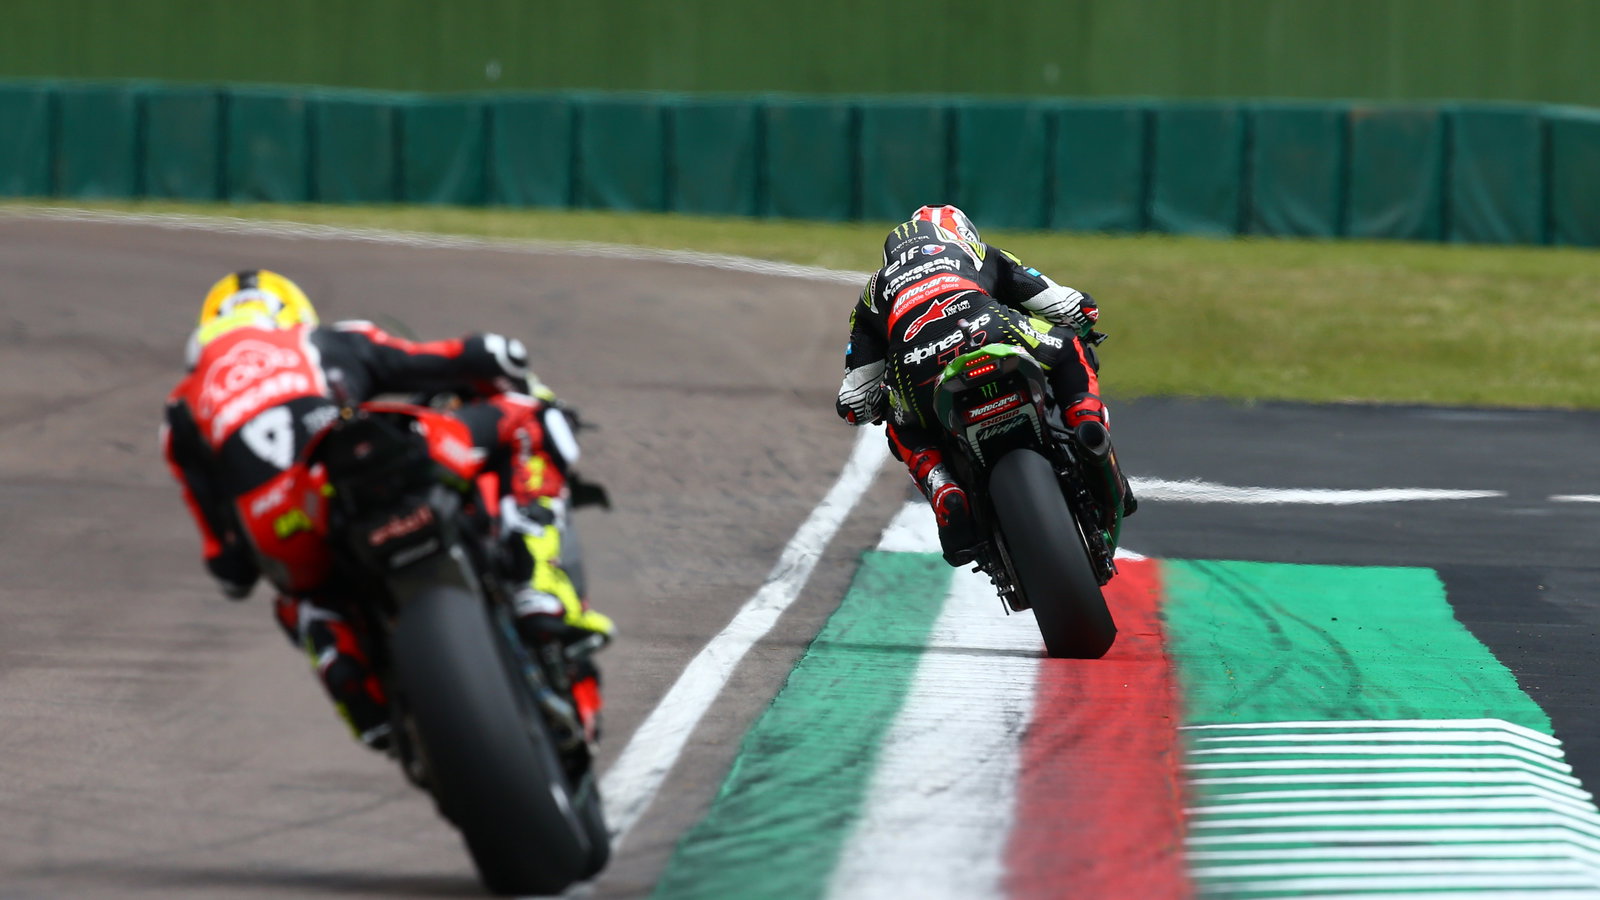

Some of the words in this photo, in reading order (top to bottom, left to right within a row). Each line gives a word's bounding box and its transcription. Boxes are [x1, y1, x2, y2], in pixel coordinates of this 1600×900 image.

[884, 245, 920, 277] elf
[882, 256, 961, 301] Kawasaki
[890, 273, 923, 297] Racing
[922, 264, 953, 275] Team
[924, 286, 940, 296] Gear
[941, 282, 960, 290] Store
[903, 313, 991, 365] alpinesars
[979, 418, 1027, 441] Ninja
